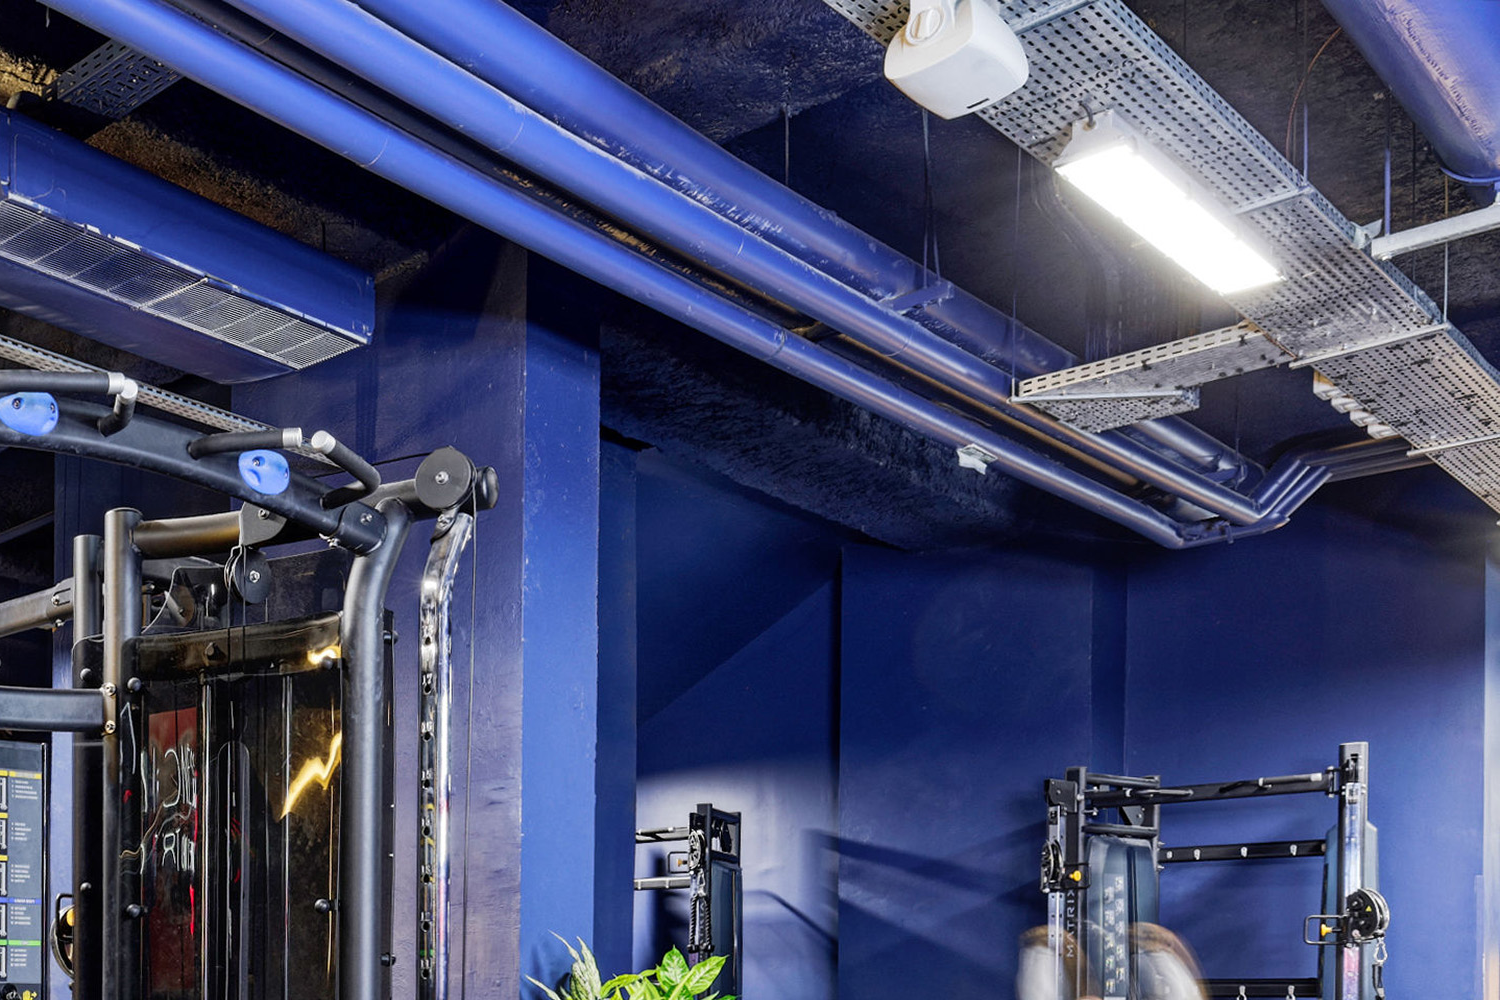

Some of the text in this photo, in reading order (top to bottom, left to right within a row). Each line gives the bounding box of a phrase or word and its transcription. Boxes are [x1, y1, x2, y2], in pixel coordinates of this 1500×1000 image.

[422, 673, 433, 686] 17
[421, 721, 434, 733] 16
[420, 911, 431, 922] 12
[420, 959, 430, 969] 11
